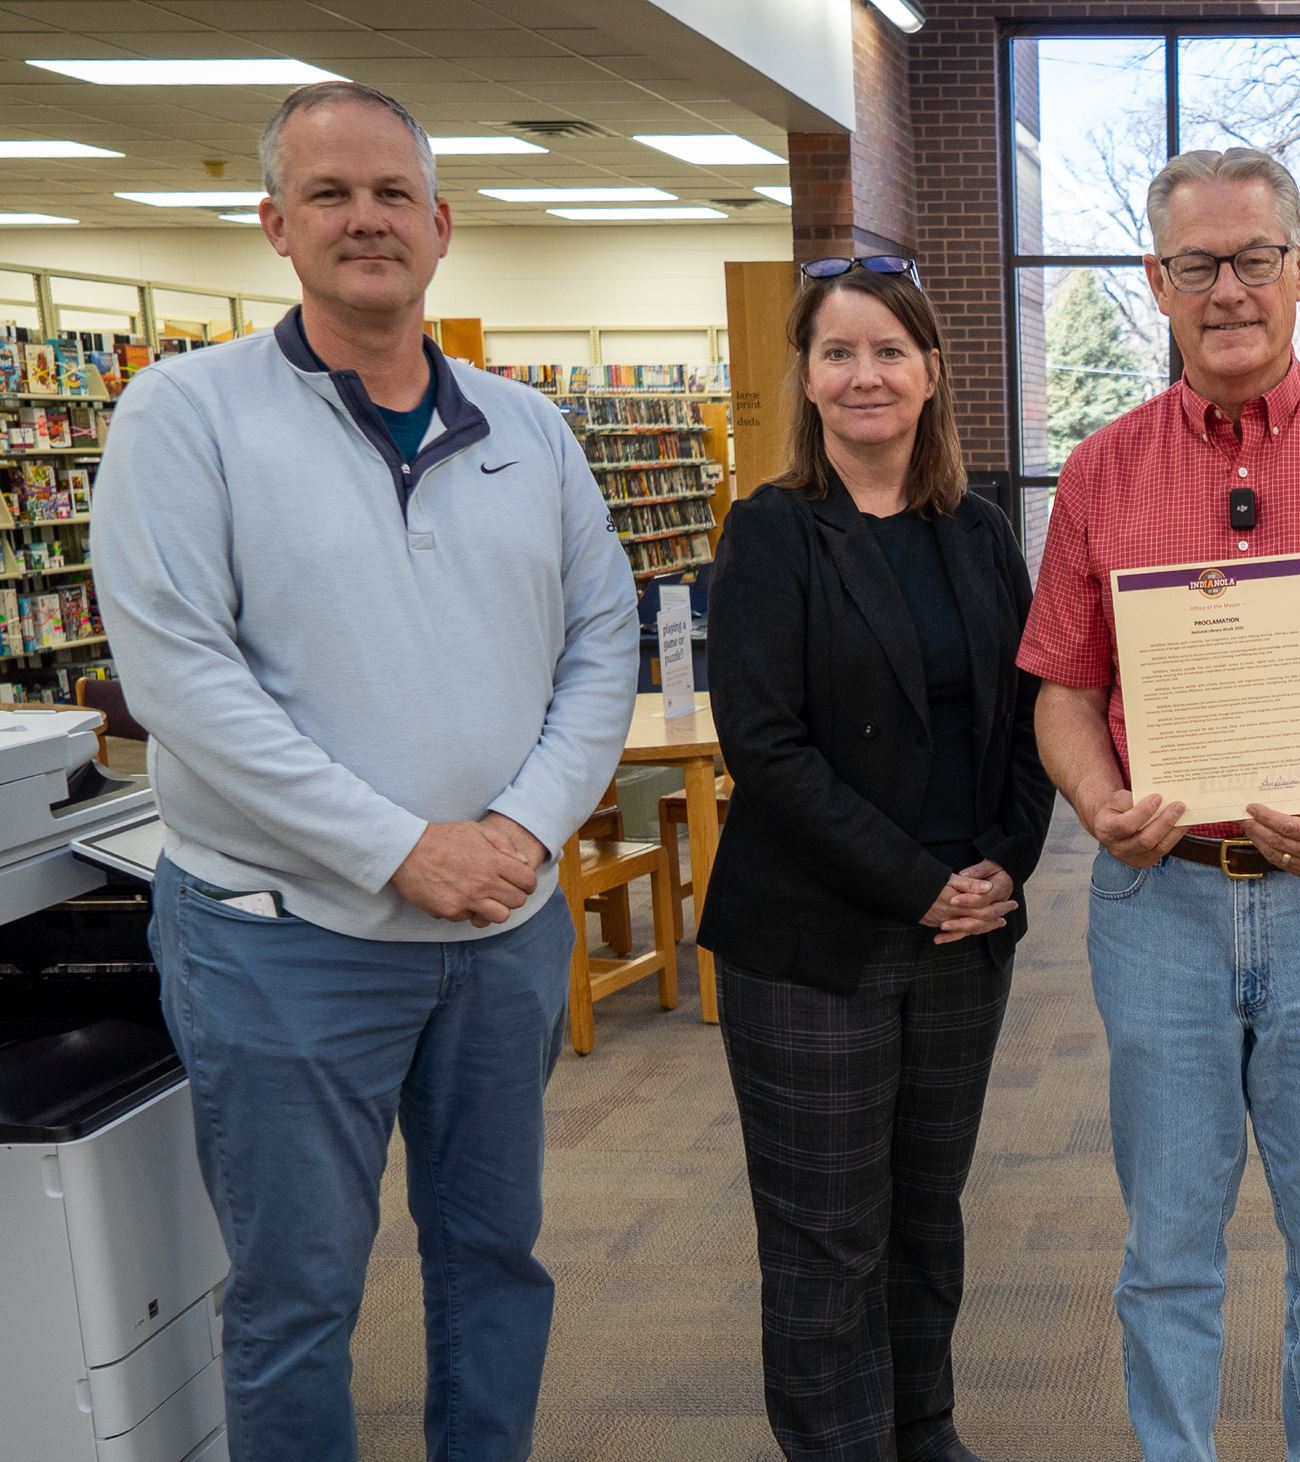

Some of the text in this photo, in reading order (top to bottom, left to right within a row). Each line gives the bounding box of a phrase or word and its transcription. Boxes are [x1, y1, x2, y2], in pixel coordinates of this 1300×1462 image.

[1190, 578, 1236, 590] INDIANOLA
[1194, 617, 1240, 626] PROCLAMATION
[662, 622, 682, 637] playing
